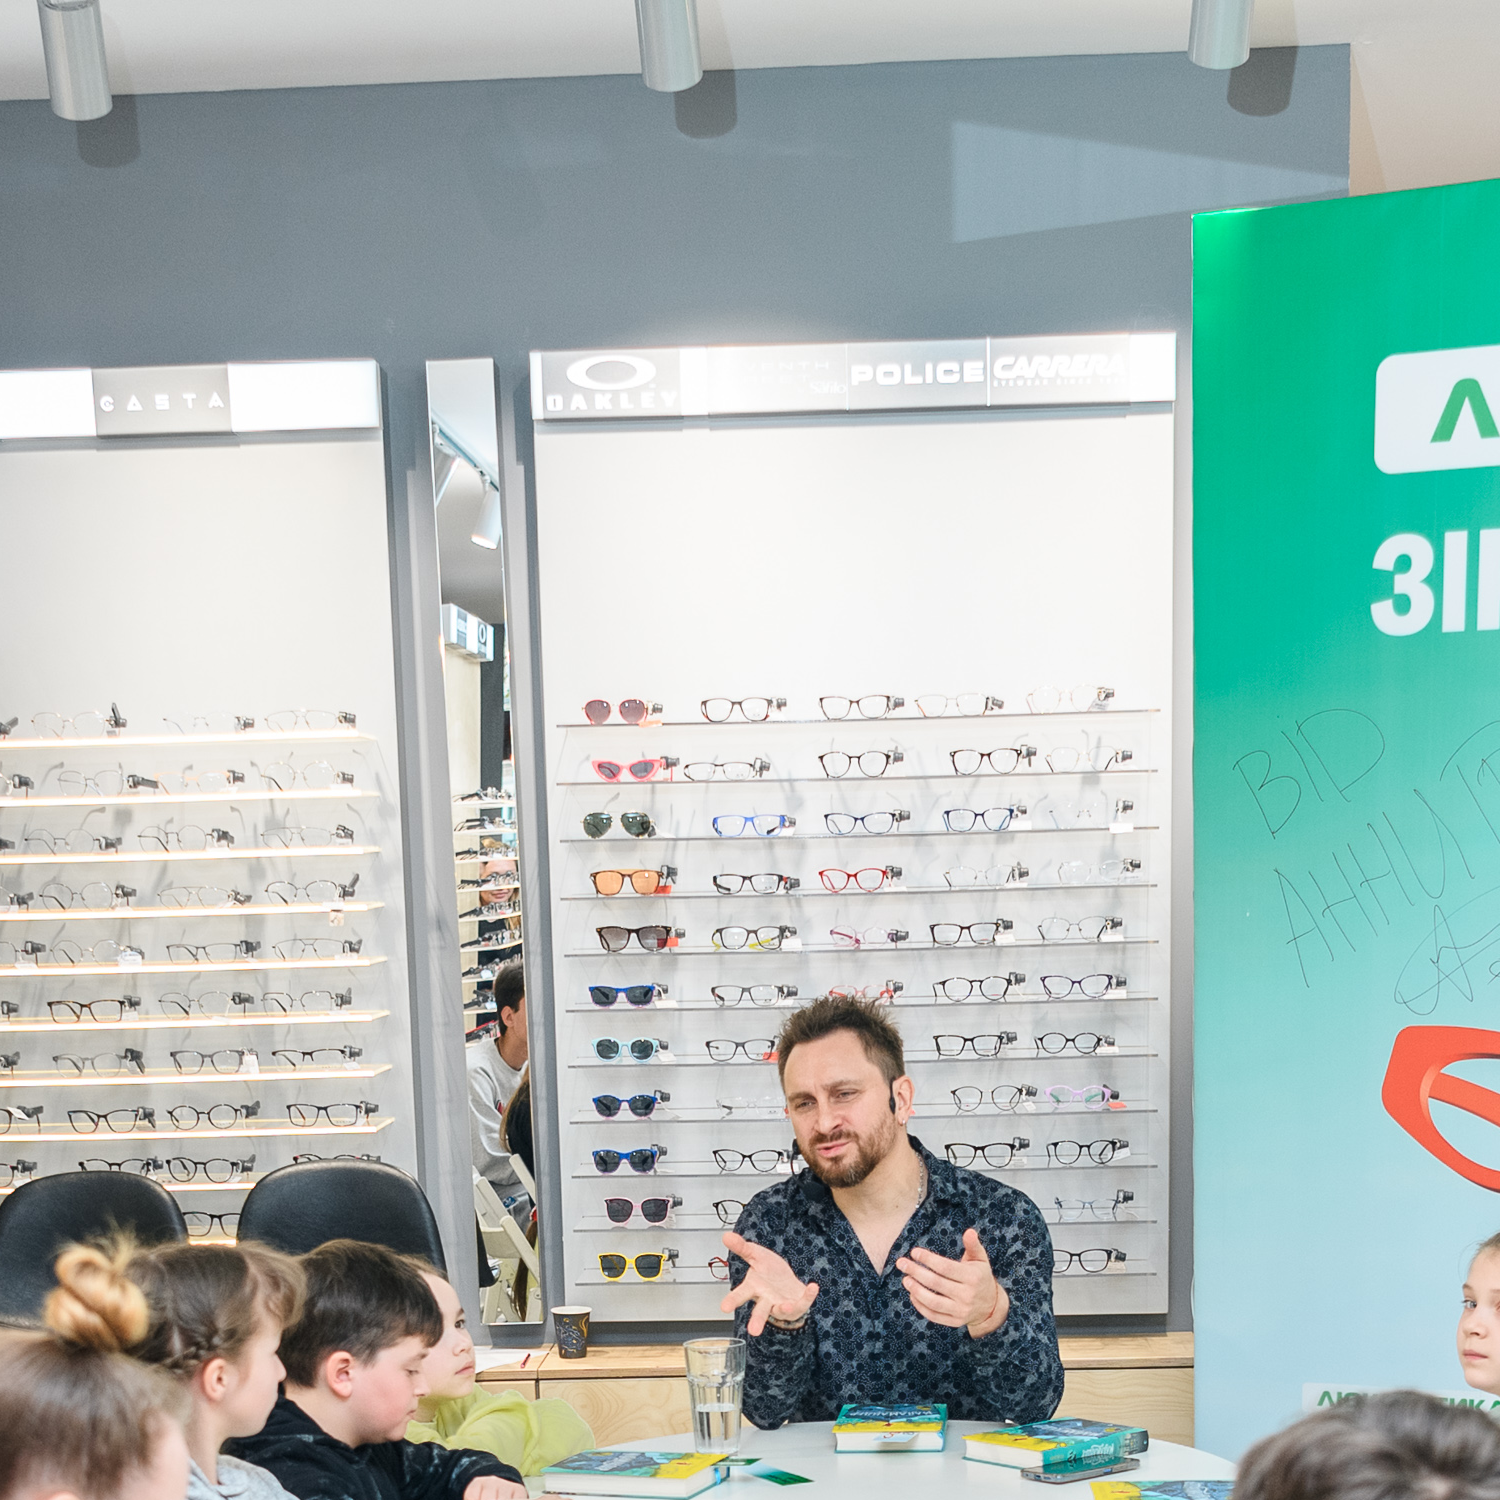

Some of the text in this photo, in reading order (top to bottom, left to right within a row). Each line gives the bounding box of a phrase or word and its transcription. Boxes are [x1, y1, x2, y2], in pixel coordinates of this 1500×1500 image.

[851, 361, 985, 386] POLICE
[993, 353, 1127, 380] CARRERA
[100, 391, 225, 412] CASTA
[546, 391, 678, 412] OAKLEY
